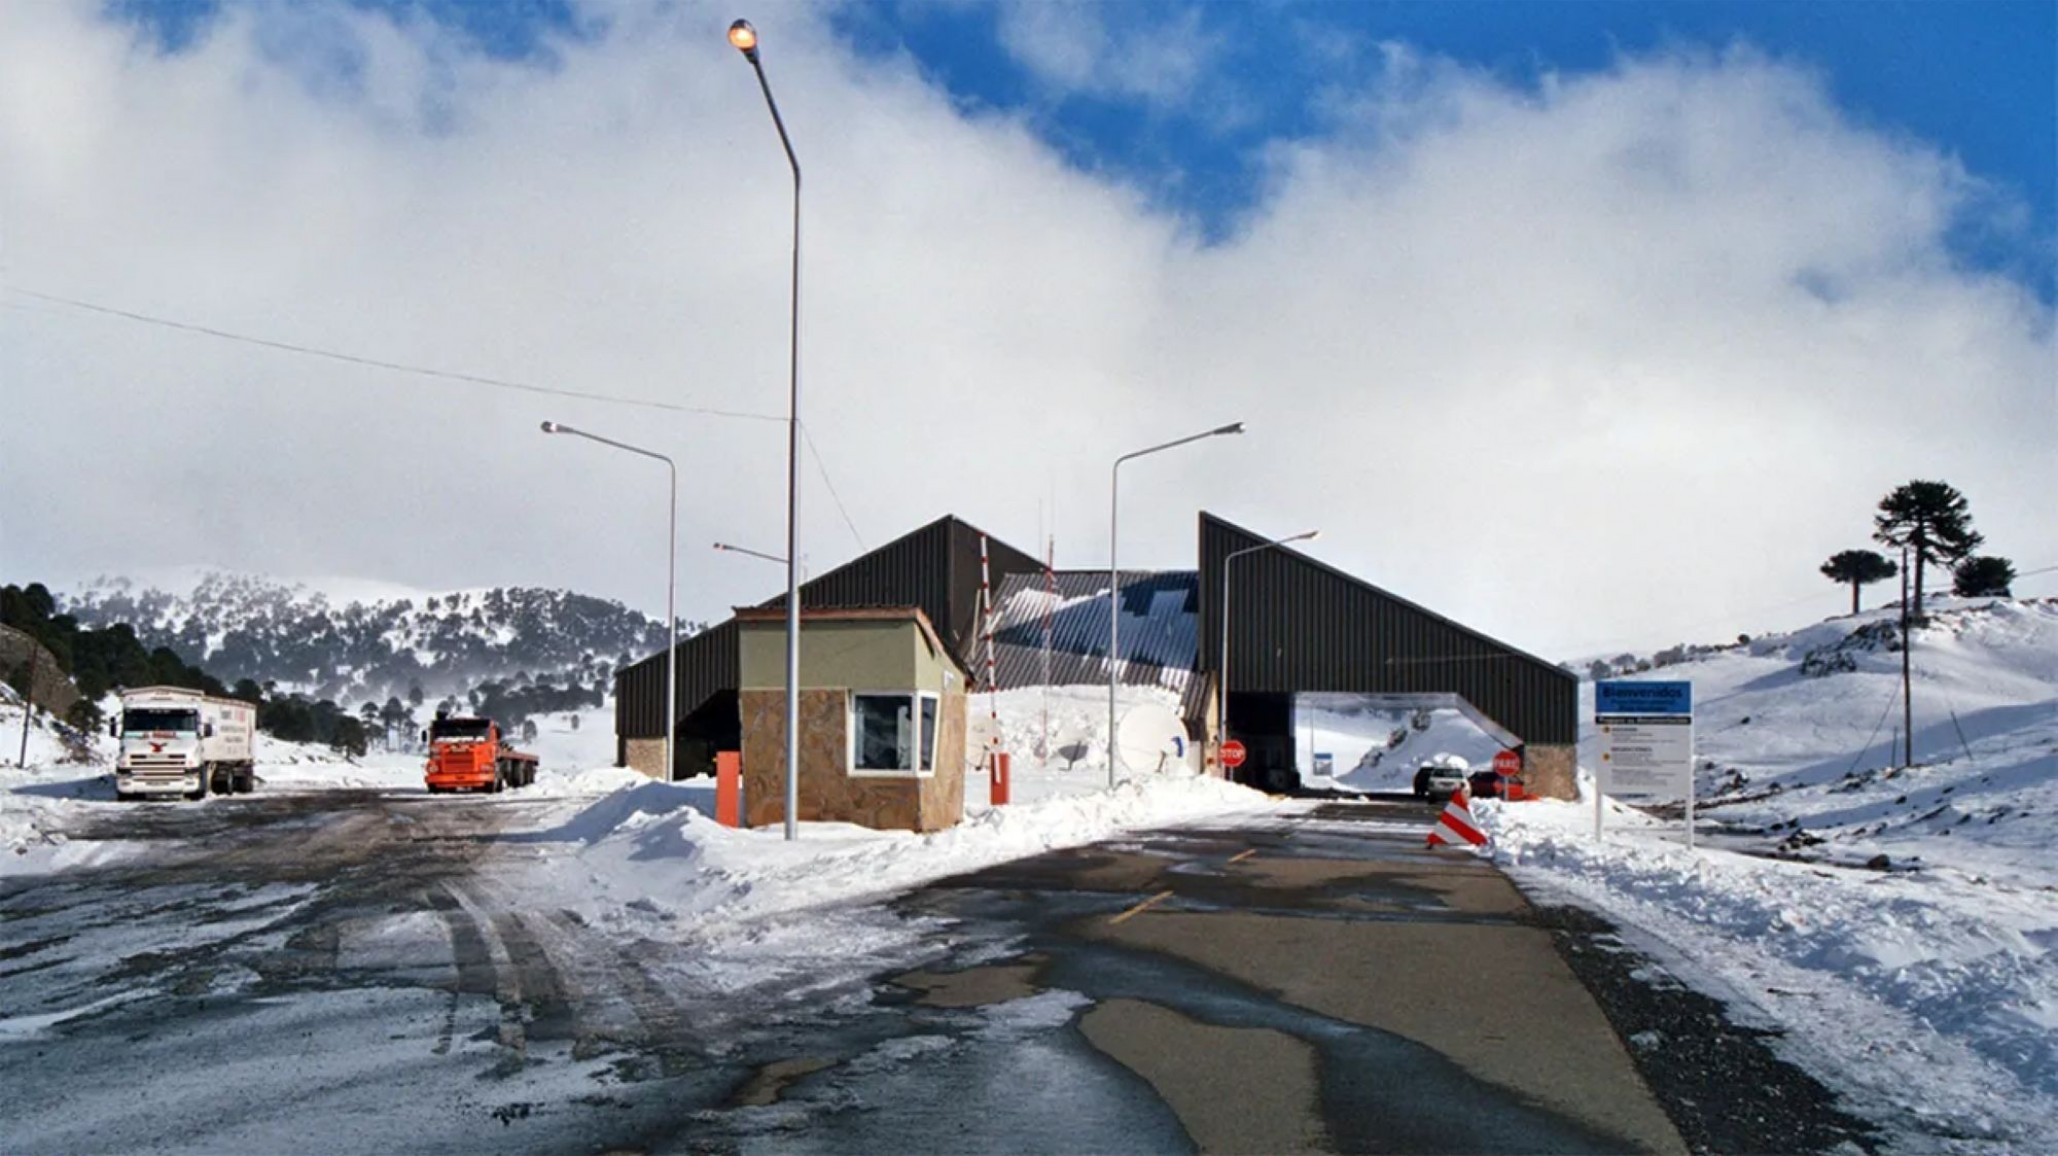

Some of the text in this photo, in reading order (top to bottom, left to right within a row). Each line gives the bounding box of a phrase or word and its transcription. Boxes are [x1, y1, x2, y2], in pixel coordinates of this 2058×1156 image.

[1602, 686, 1682, 698] Bienvenidos
[1220, 748, 1244, 759] STOP
[1494, 758, 1519, 769] PARE
